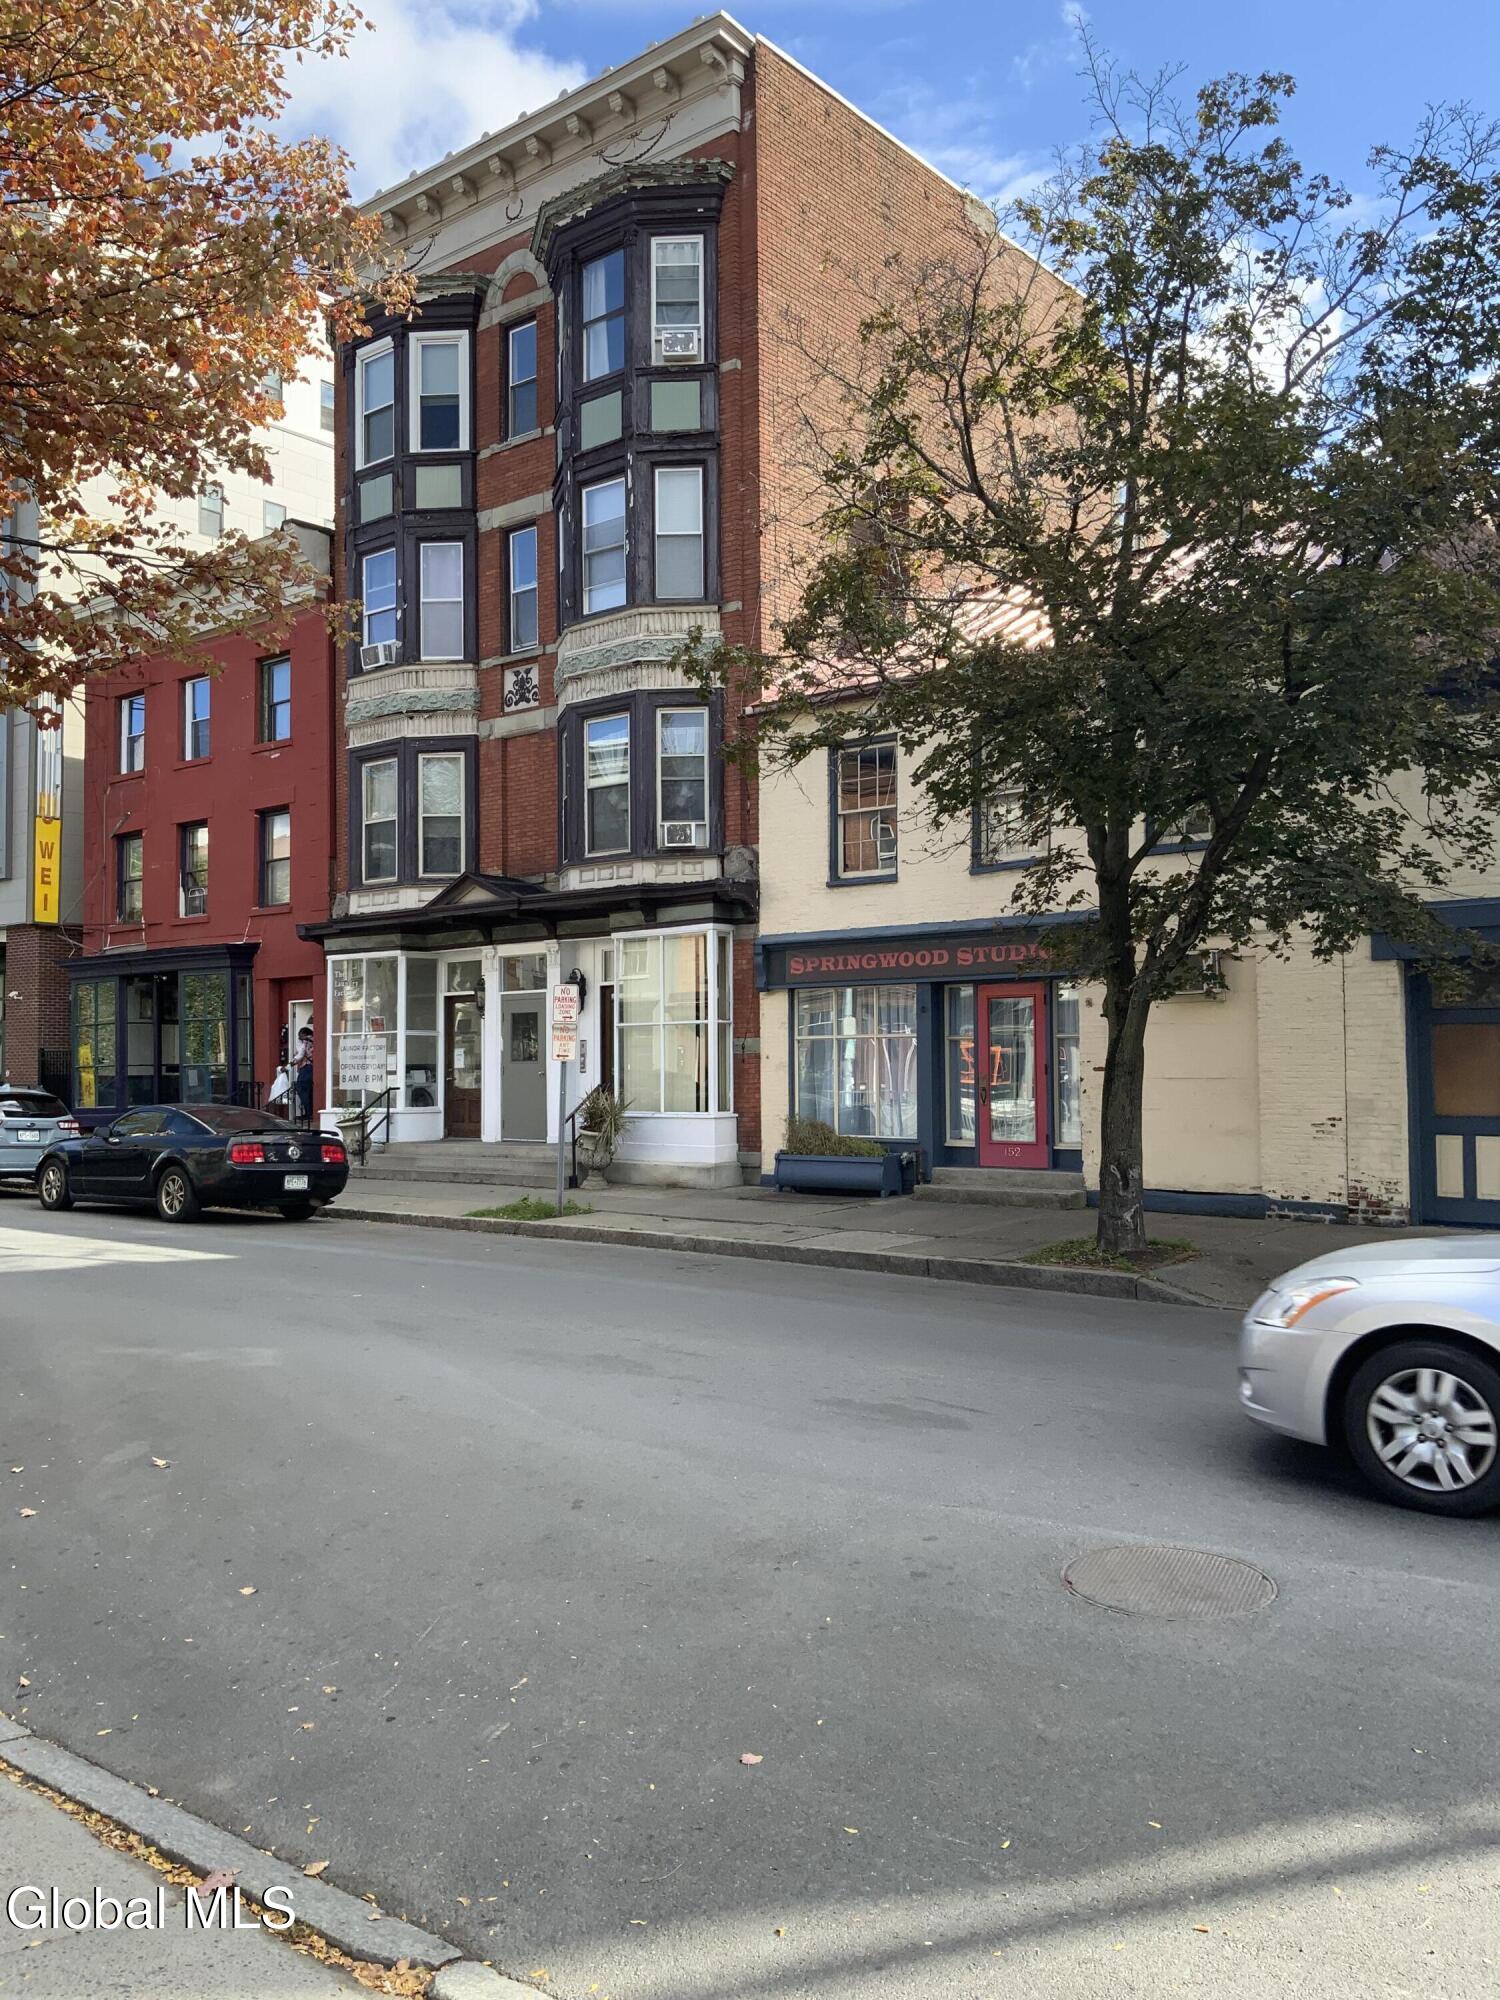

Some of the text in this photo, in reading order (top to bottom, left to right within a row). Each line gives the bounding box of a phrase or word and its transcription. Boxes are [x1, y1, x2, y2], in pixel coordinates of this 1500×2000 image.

[39, 840, 55, 912] WEI
[790, 950, 949, 975] SPRINGWOOD
[560, 988, 571, 996] NO
[560, 1026, 570, 1034] NO
[553, 1034, 576, 1042] PARKING
[341, 1063, 356, 1071] OPEN
[348, 1074, 360, 1082] AM
[372, 1073, 383, 1082] PM
